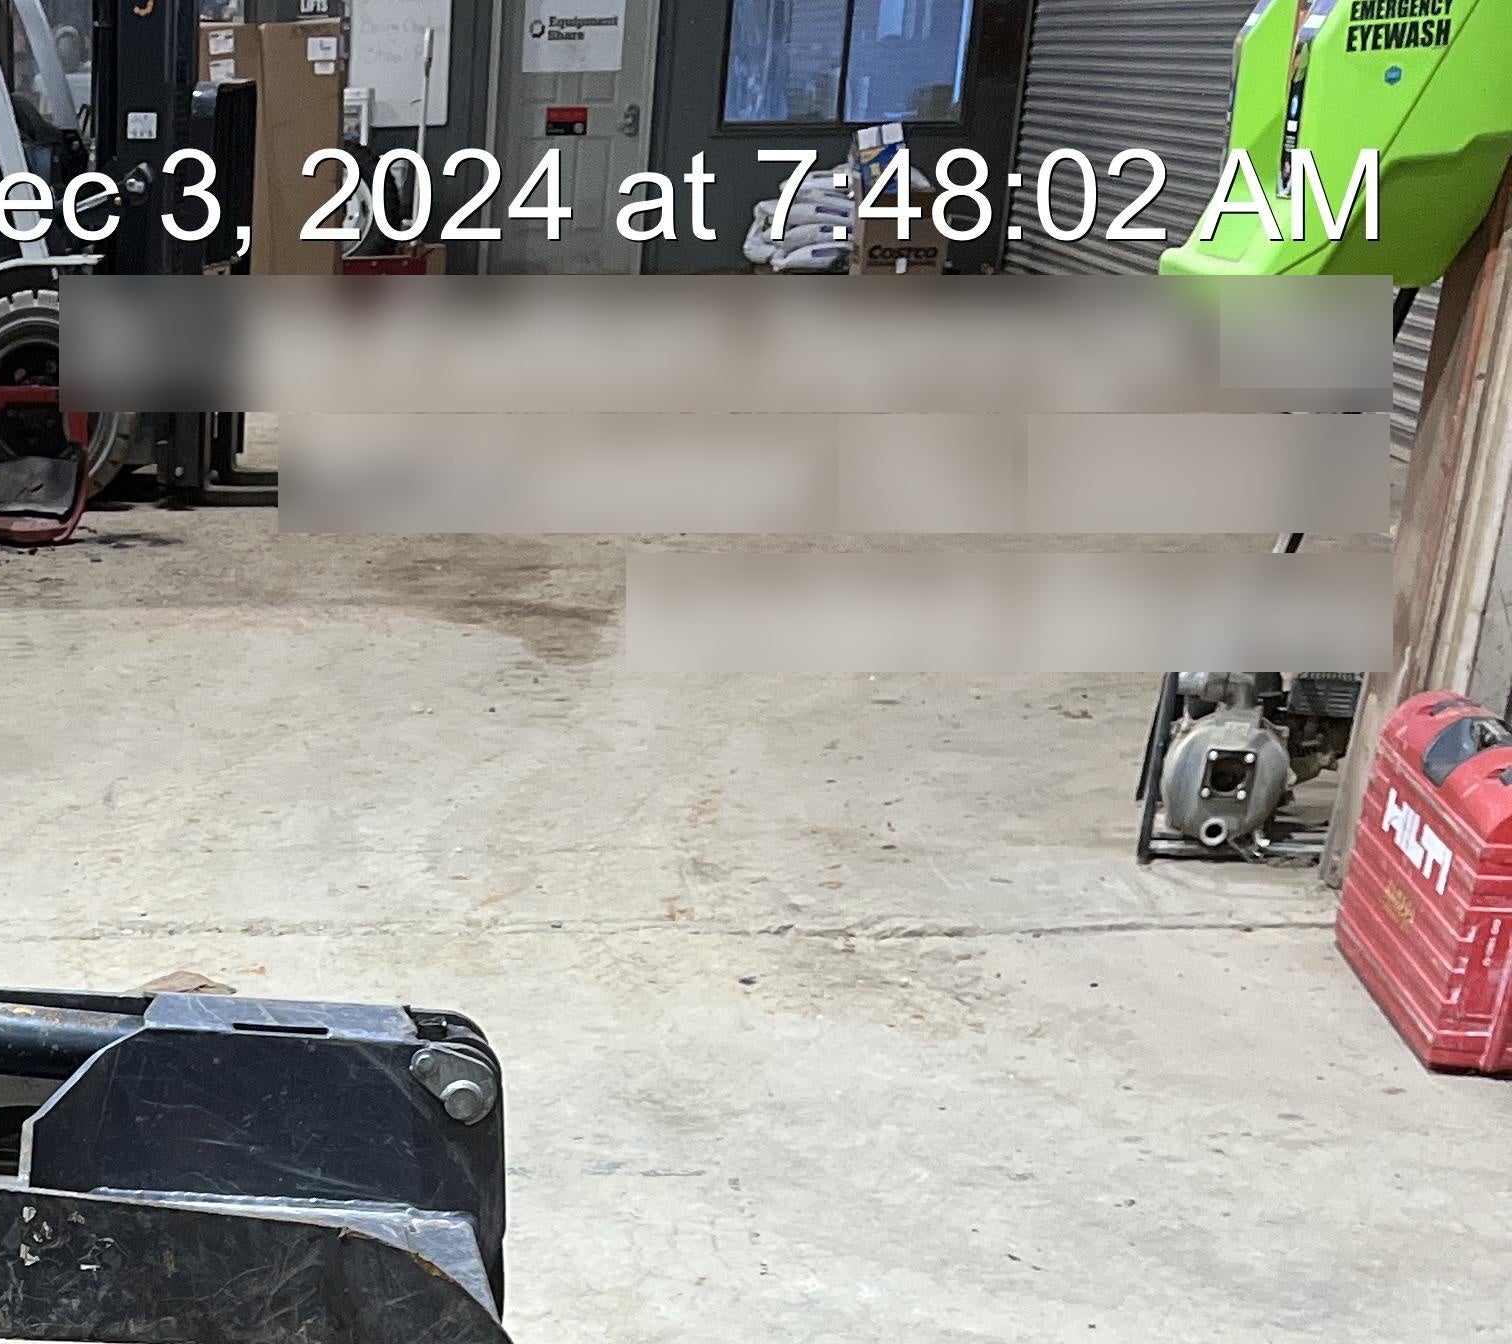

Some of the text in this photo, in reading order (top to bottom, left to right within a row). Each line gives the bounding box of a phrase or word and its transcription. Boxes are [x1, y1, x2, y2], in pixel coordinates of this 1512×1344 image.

[549, 16, 617, 29] Equipment
[1349, 0, 1453, 21] EMERGENCY
[1346, 18, 1452, 52] EYEWASH
[1381, 787, 1453, 896] HILTI
